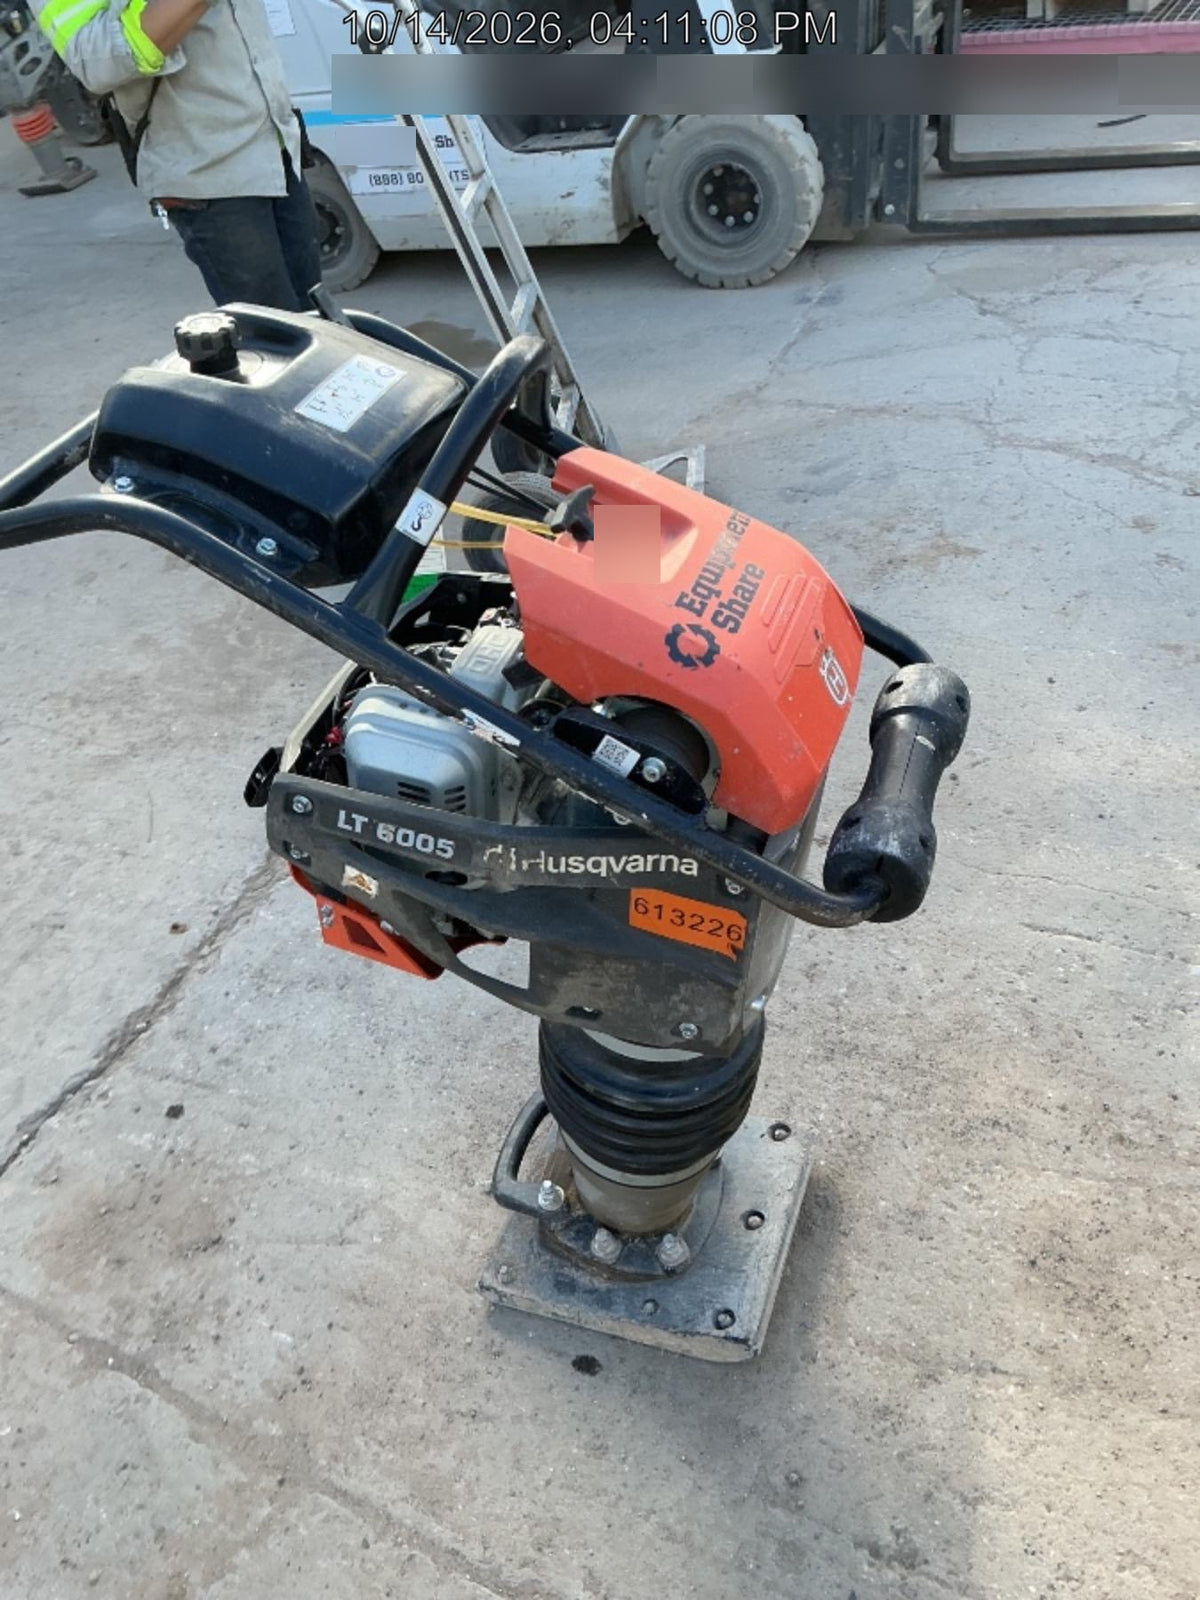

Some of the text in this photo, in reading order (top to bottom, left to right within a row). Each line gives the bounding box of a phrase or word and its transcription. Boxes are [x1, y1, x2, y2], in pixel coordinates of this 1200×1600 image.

[710, 562, 766, 634] Share
[336, 809, 456, 860] LT 6005
[633, 896, 743, 943] 613226
